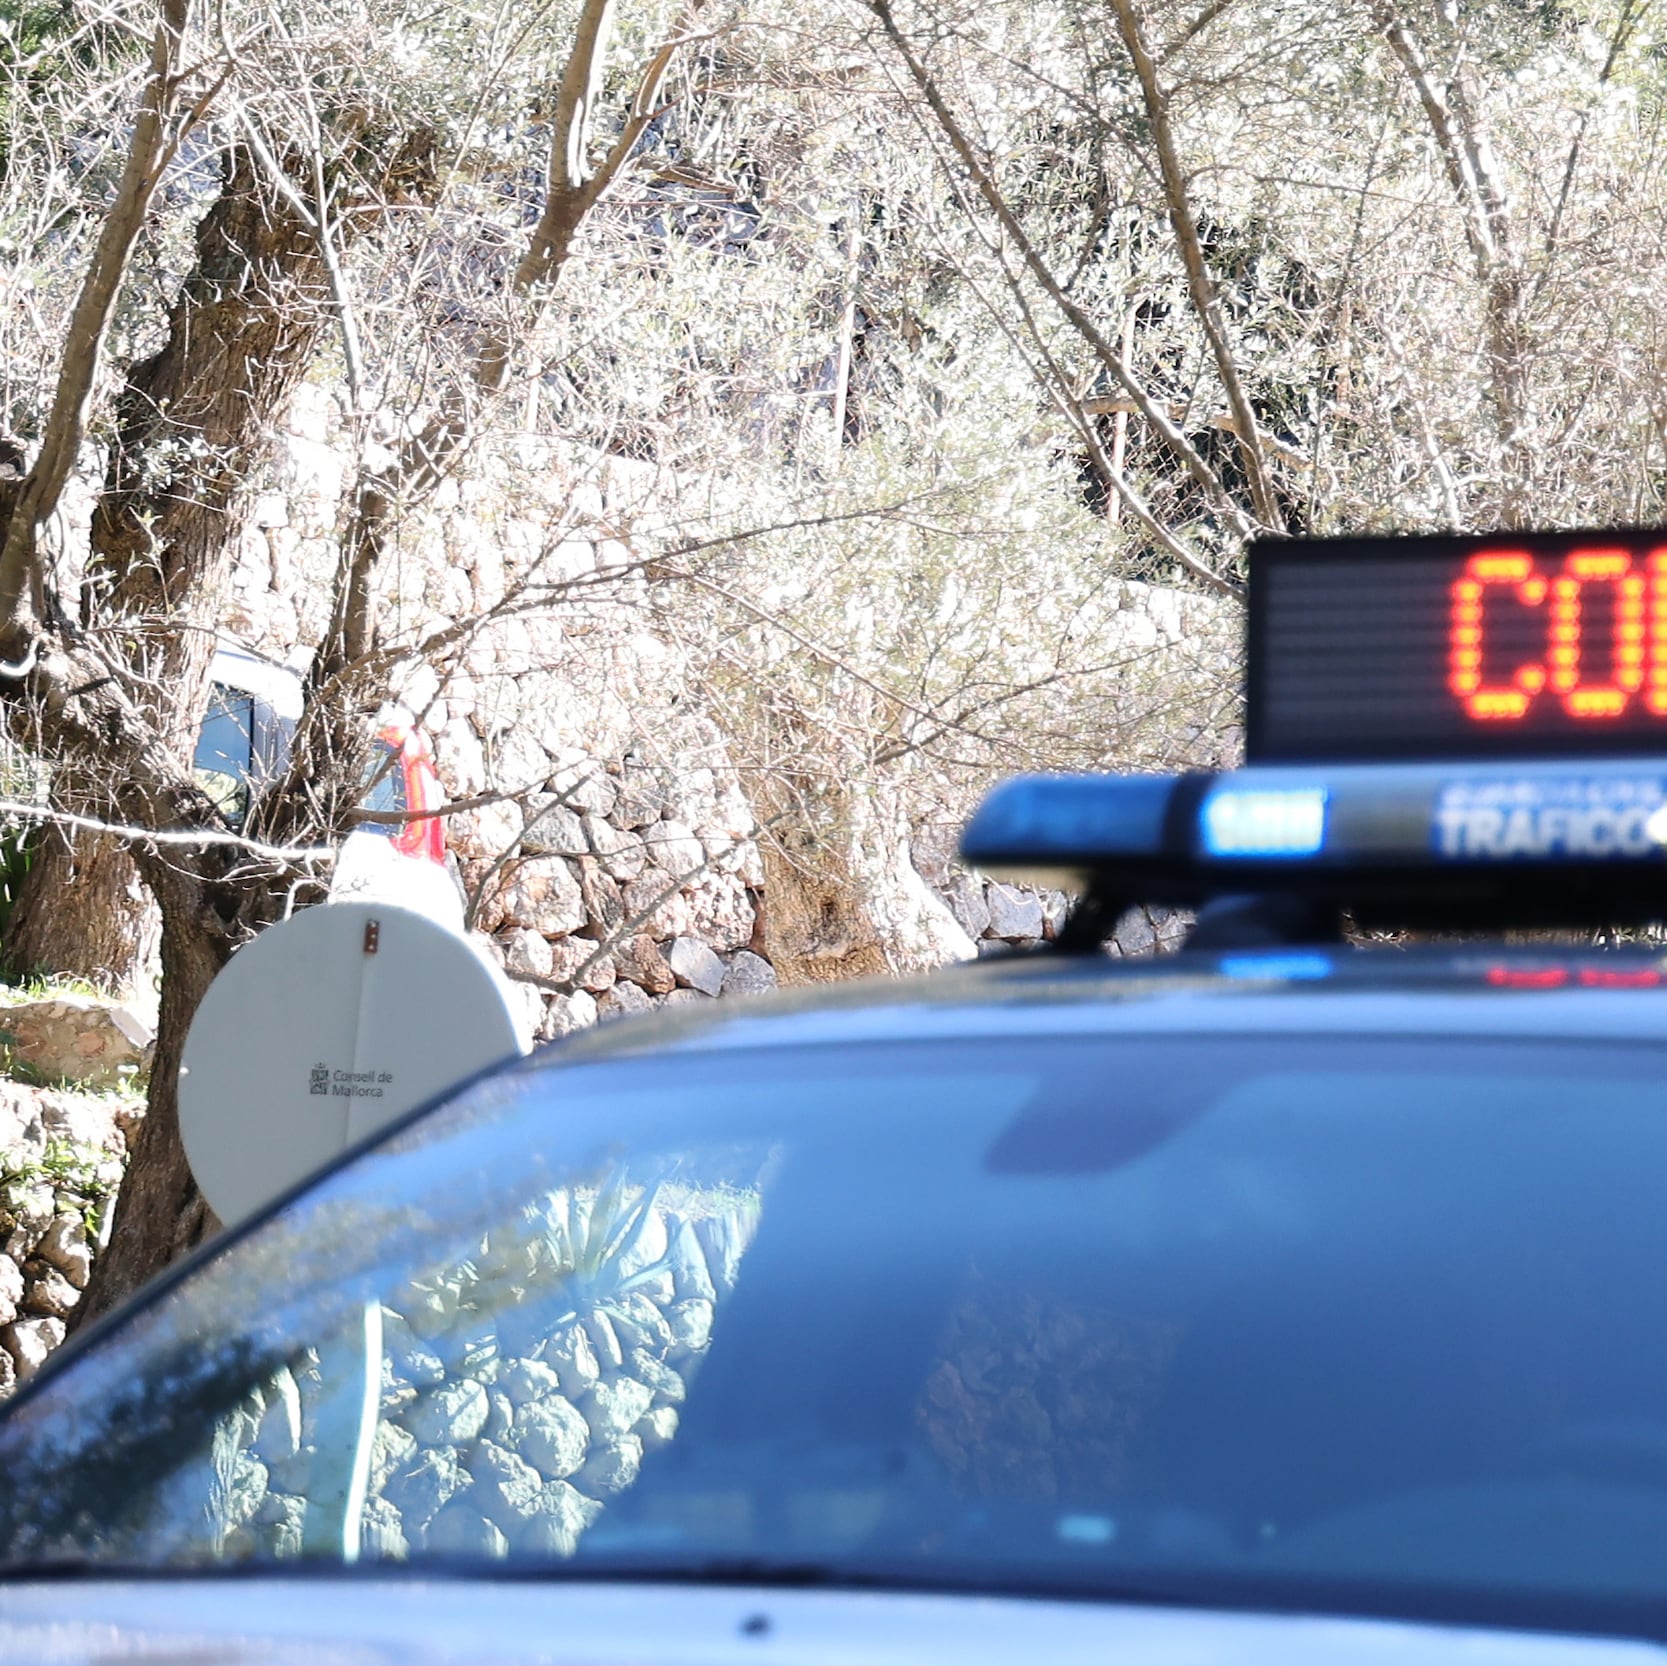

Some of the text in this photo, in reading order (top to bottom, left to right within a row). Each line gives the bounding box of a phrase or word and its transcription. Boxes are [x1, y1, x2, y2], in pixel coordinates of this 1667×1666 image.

[333, 1069, 393, 1083] Consell de
[331, 1084, 384, 1098] Mallorca
